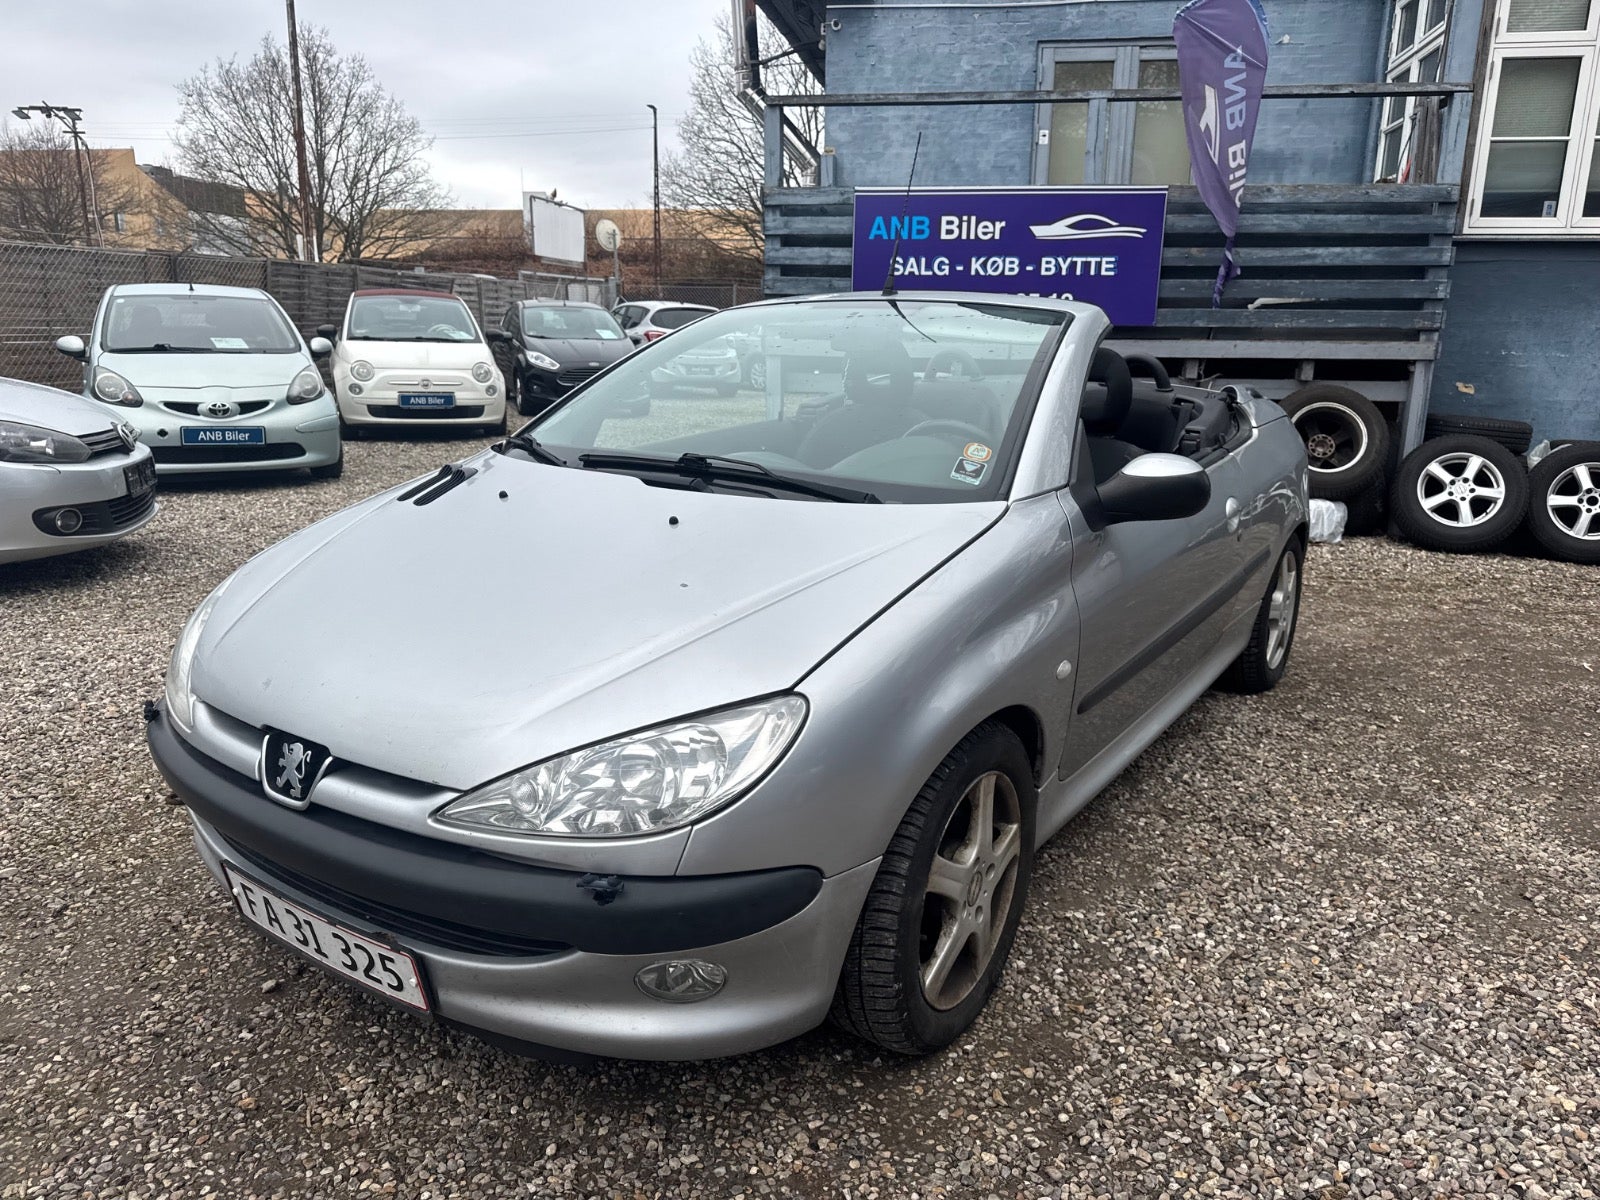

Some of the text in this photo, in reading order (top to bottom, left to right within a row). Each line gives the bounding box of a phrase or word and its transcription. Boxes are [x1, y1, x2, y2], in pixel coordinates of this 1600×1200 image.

[869, 215, 1006, 240] ANB Biler
[890, 256, 950, 276] SALG
[970, 256, 1020, 276] KØB
[1040, 256, 1117, 276] BYTTE
[410, 396, 445, 405] ANB Biler
[198, 431, 250, 441] ANB Biler
[240, 881, 404, 992] FA 31 325
